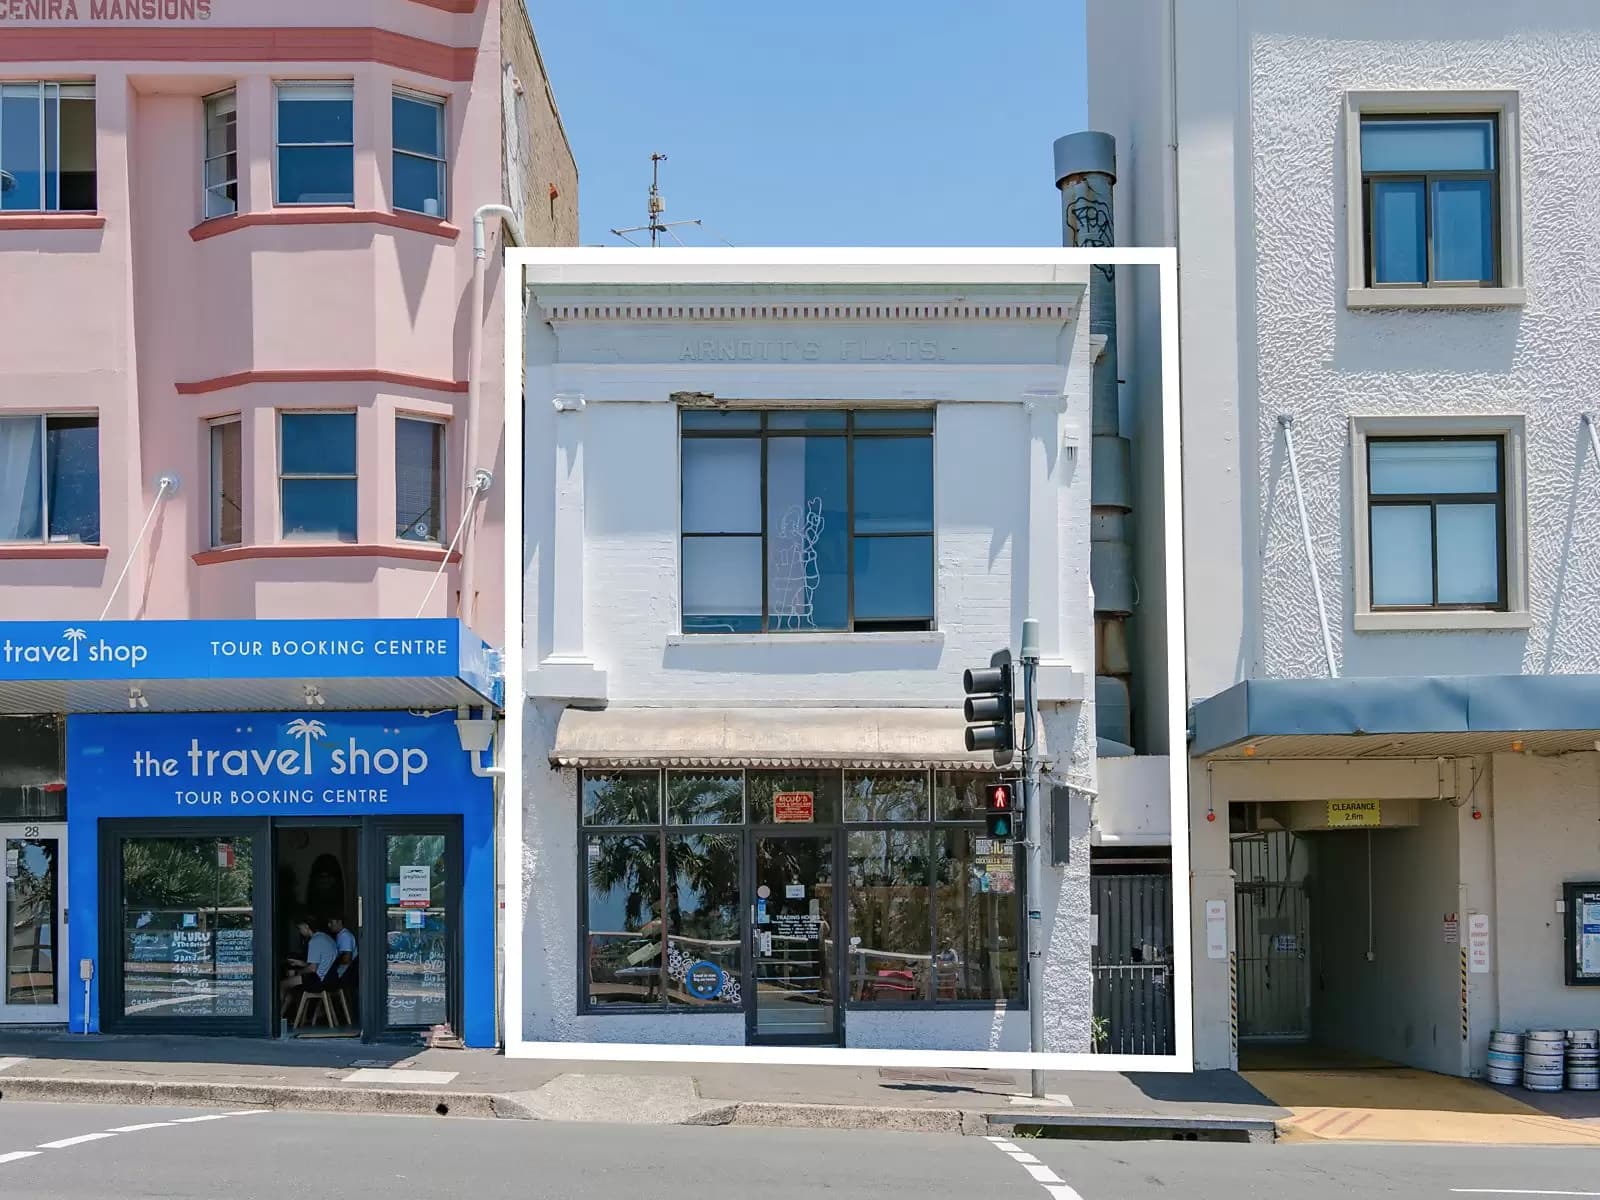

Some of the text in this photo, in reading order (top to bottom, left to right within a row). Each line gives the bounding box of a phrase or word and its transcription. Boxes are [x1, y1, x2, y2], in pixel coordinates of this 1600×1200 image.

[90, 0, 212, 20] MANSIONS
[679, 339, 821, 361] ARNOTT'S
[4, 632, 148, 668] travel shop
[210, 640, 447, 656] TOUR BOOKING CENTRE
[133, 728, 428, 786] the travel shop
[175, 789, 388, 805] TOUR BOOKING CENTRE
[1332, 802, 1376, 811] CLEARANCE
[25, 826, 39, 837] 28
